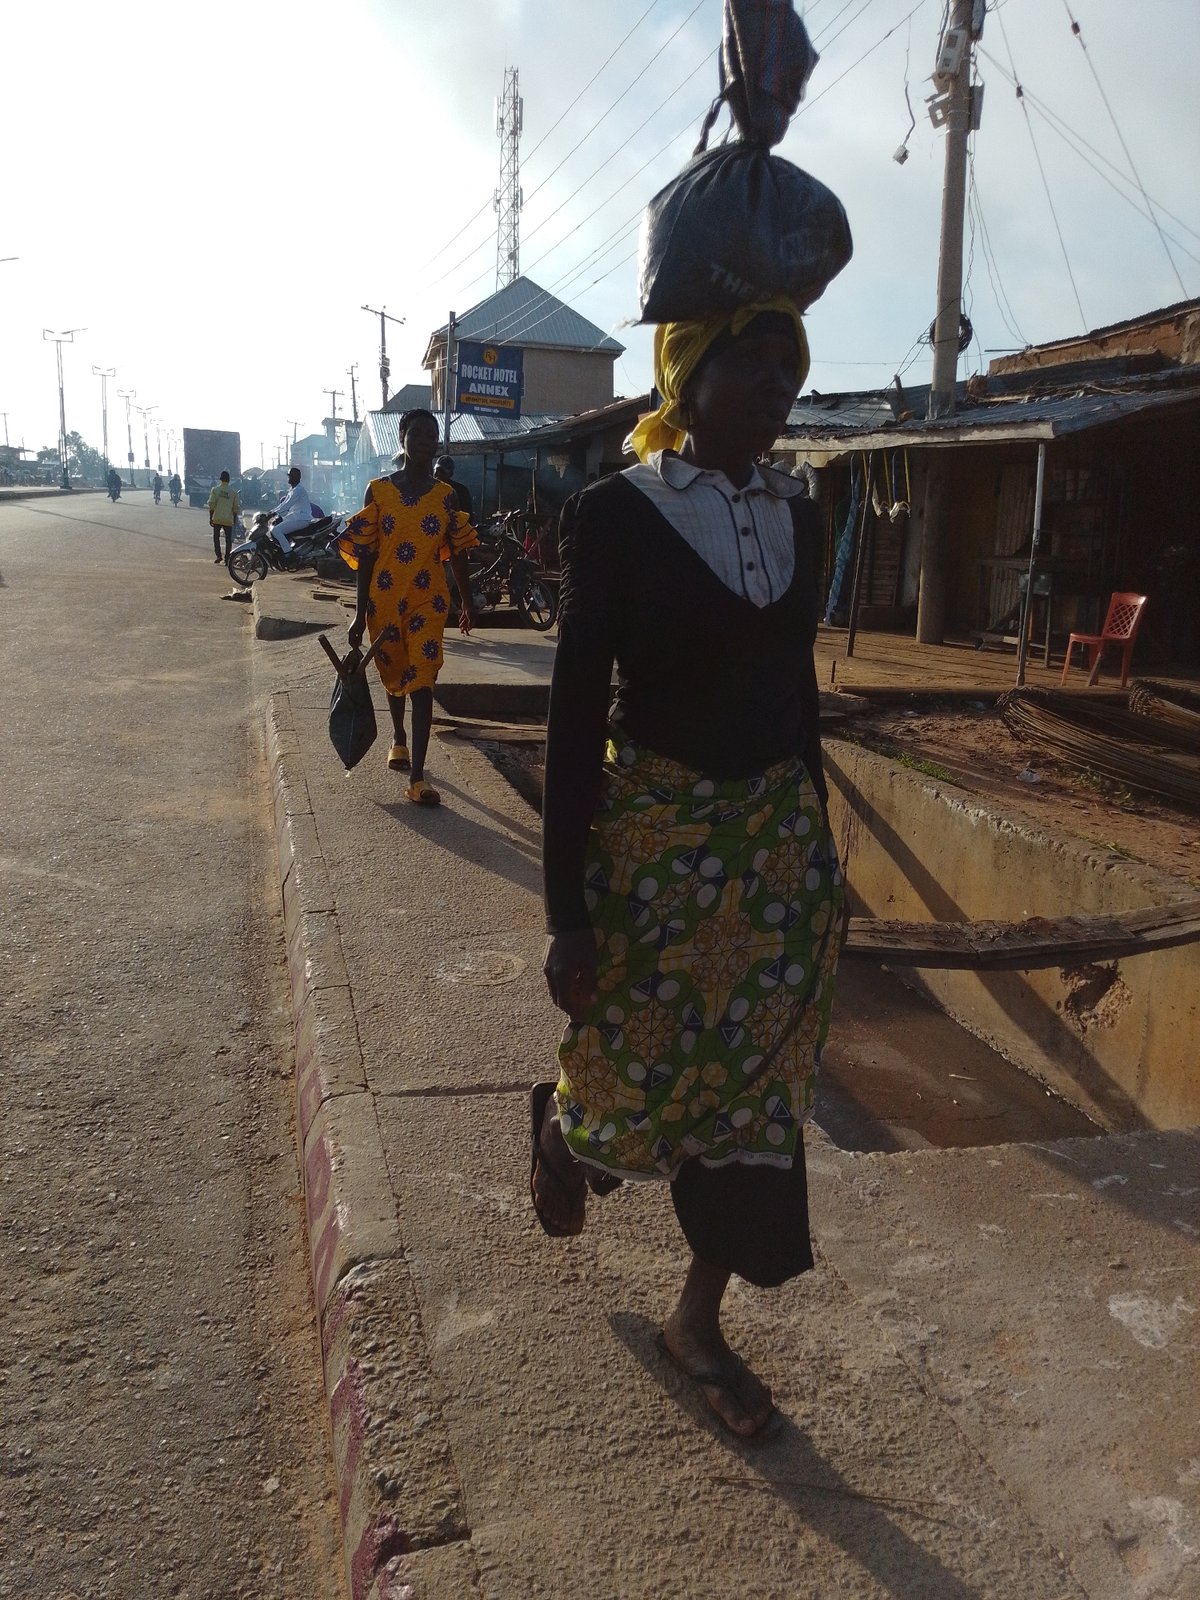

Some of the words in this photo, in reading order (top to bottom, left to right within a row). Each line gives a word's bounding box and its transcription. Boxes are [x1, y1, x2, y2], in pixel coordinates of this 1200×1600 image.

[461, 364, 492, 381] ROCKET
[493, 368, 517, 384] HOTEL
[468, 382, 509, 397] ANNEX
